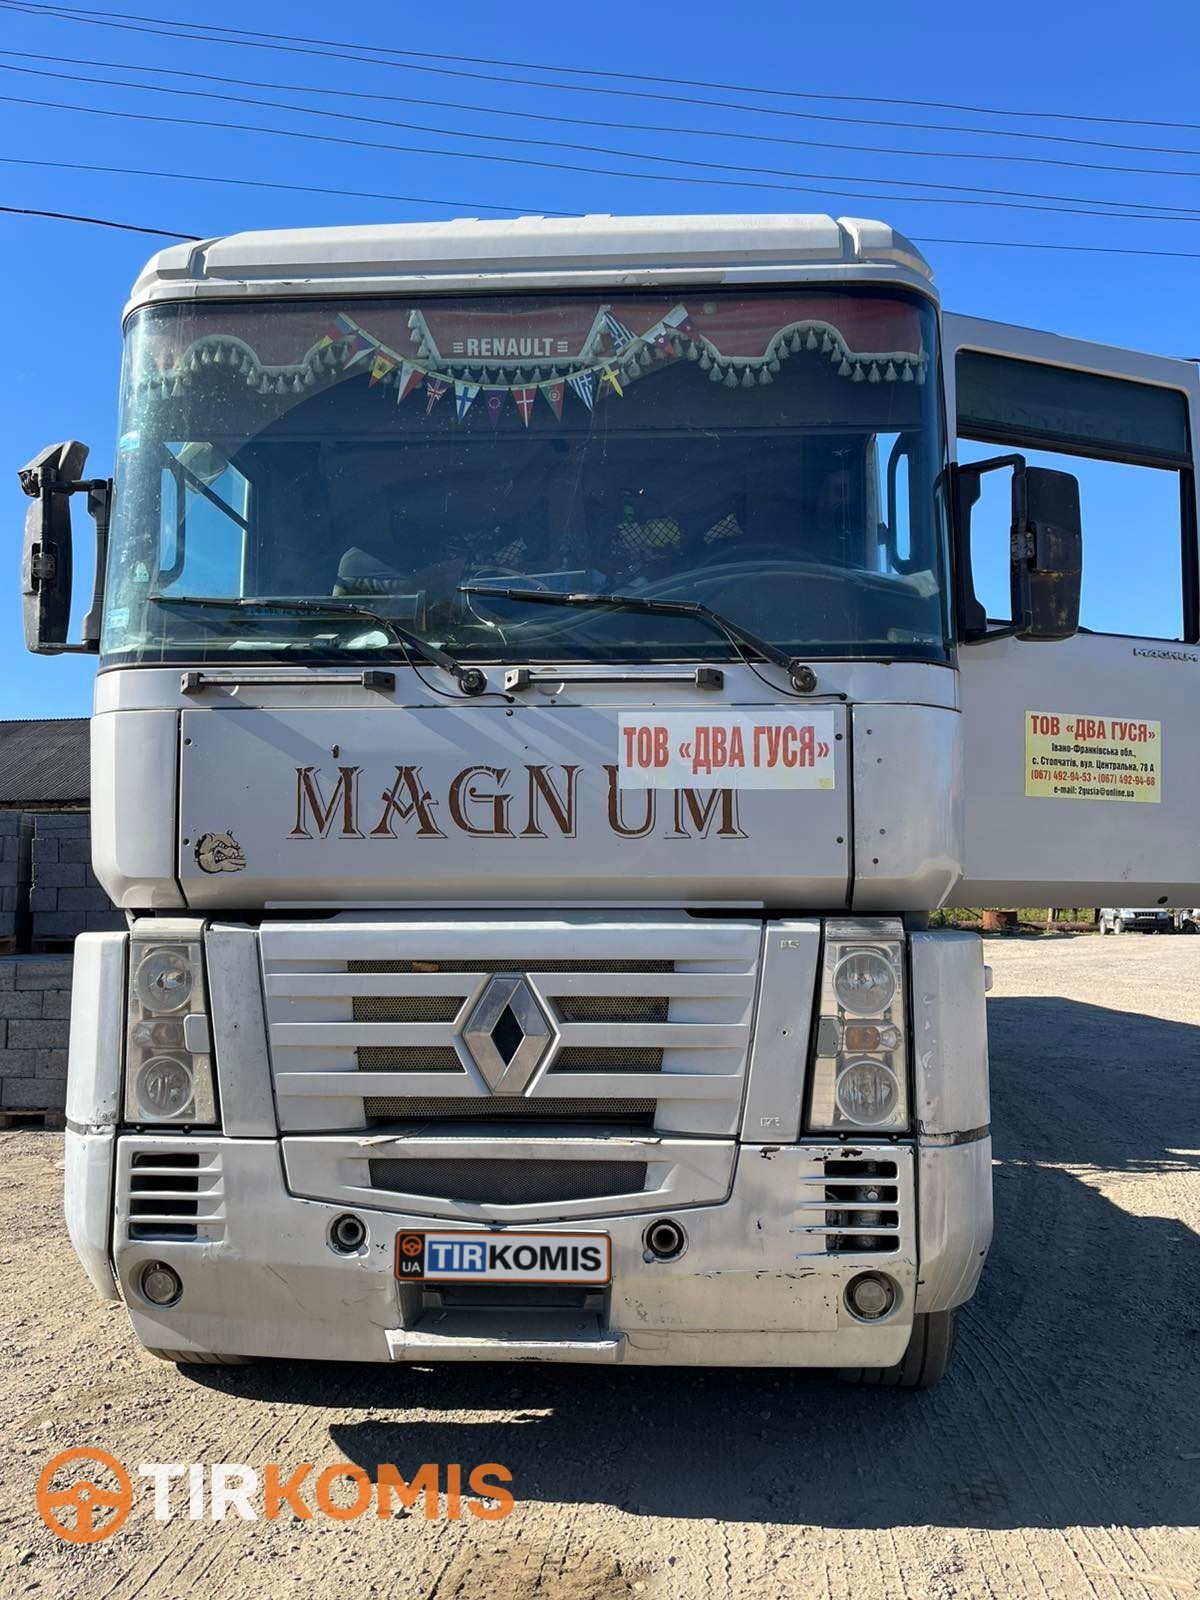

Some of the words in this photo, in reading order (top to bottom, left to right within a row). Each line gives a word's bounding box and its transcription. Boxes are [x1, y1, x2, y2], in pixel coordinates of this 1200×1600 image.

[467, 338, 554, 356] RENAULT
[1031, 715, 1060, 736] ТОВ
[1066, 719, 1107, 741] «ДВА
[1111, 722, 1156, 743] ГУСЯ»
[623, 726, 670, 768] ТОВ
[678, 726, 745, 775] «ДВА
[753, 725, 830, 768] ГУСЯ»
[1031, 769, 1051, 781] (067)
[1098, 774, 1117, 784] (067)
